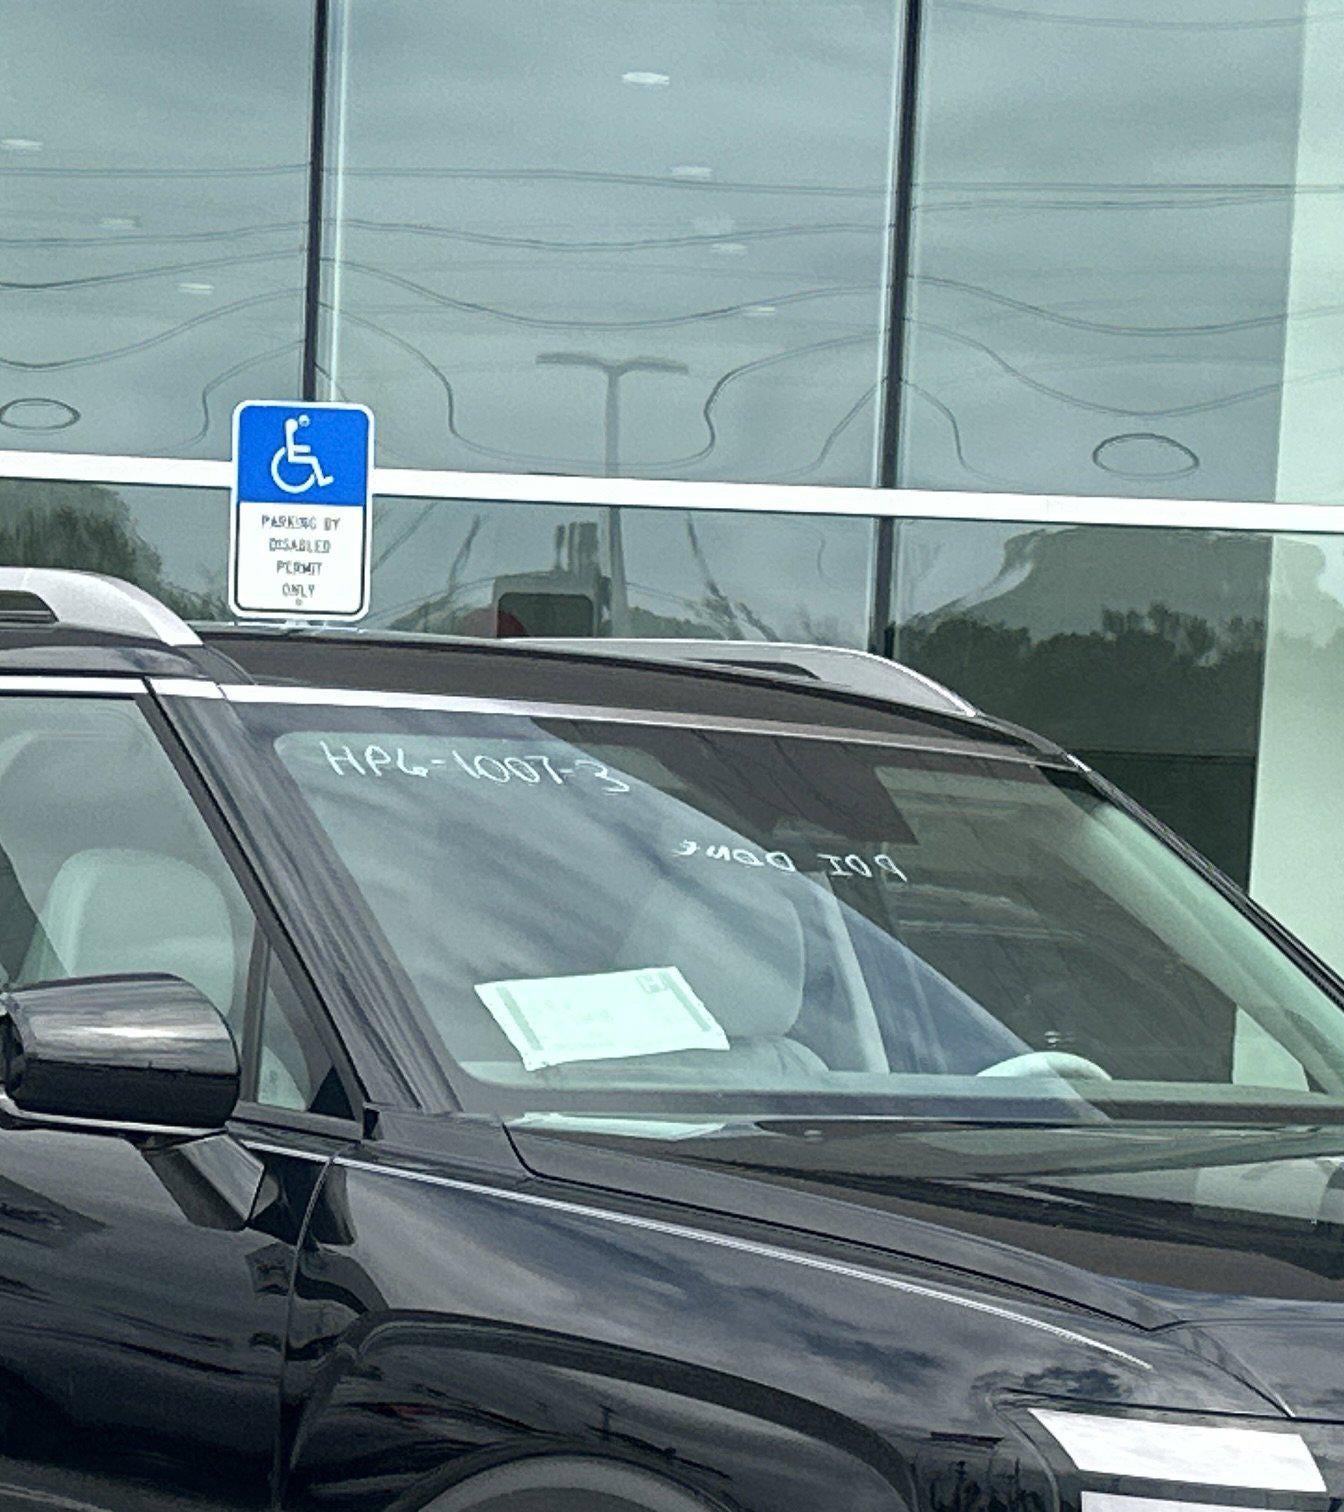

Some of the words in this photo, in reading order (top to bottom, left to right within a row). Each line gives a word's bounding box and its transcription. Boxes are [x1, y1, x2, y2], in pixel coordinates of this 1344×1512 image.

[261, 514, 317, 530] PARKING
[323, 516, 341, 531] BY
[269, 537, 331, 553] DISABLED
[276, 559, 322, 575] PERMIT
[282, 582, 315, 598] ONLY
